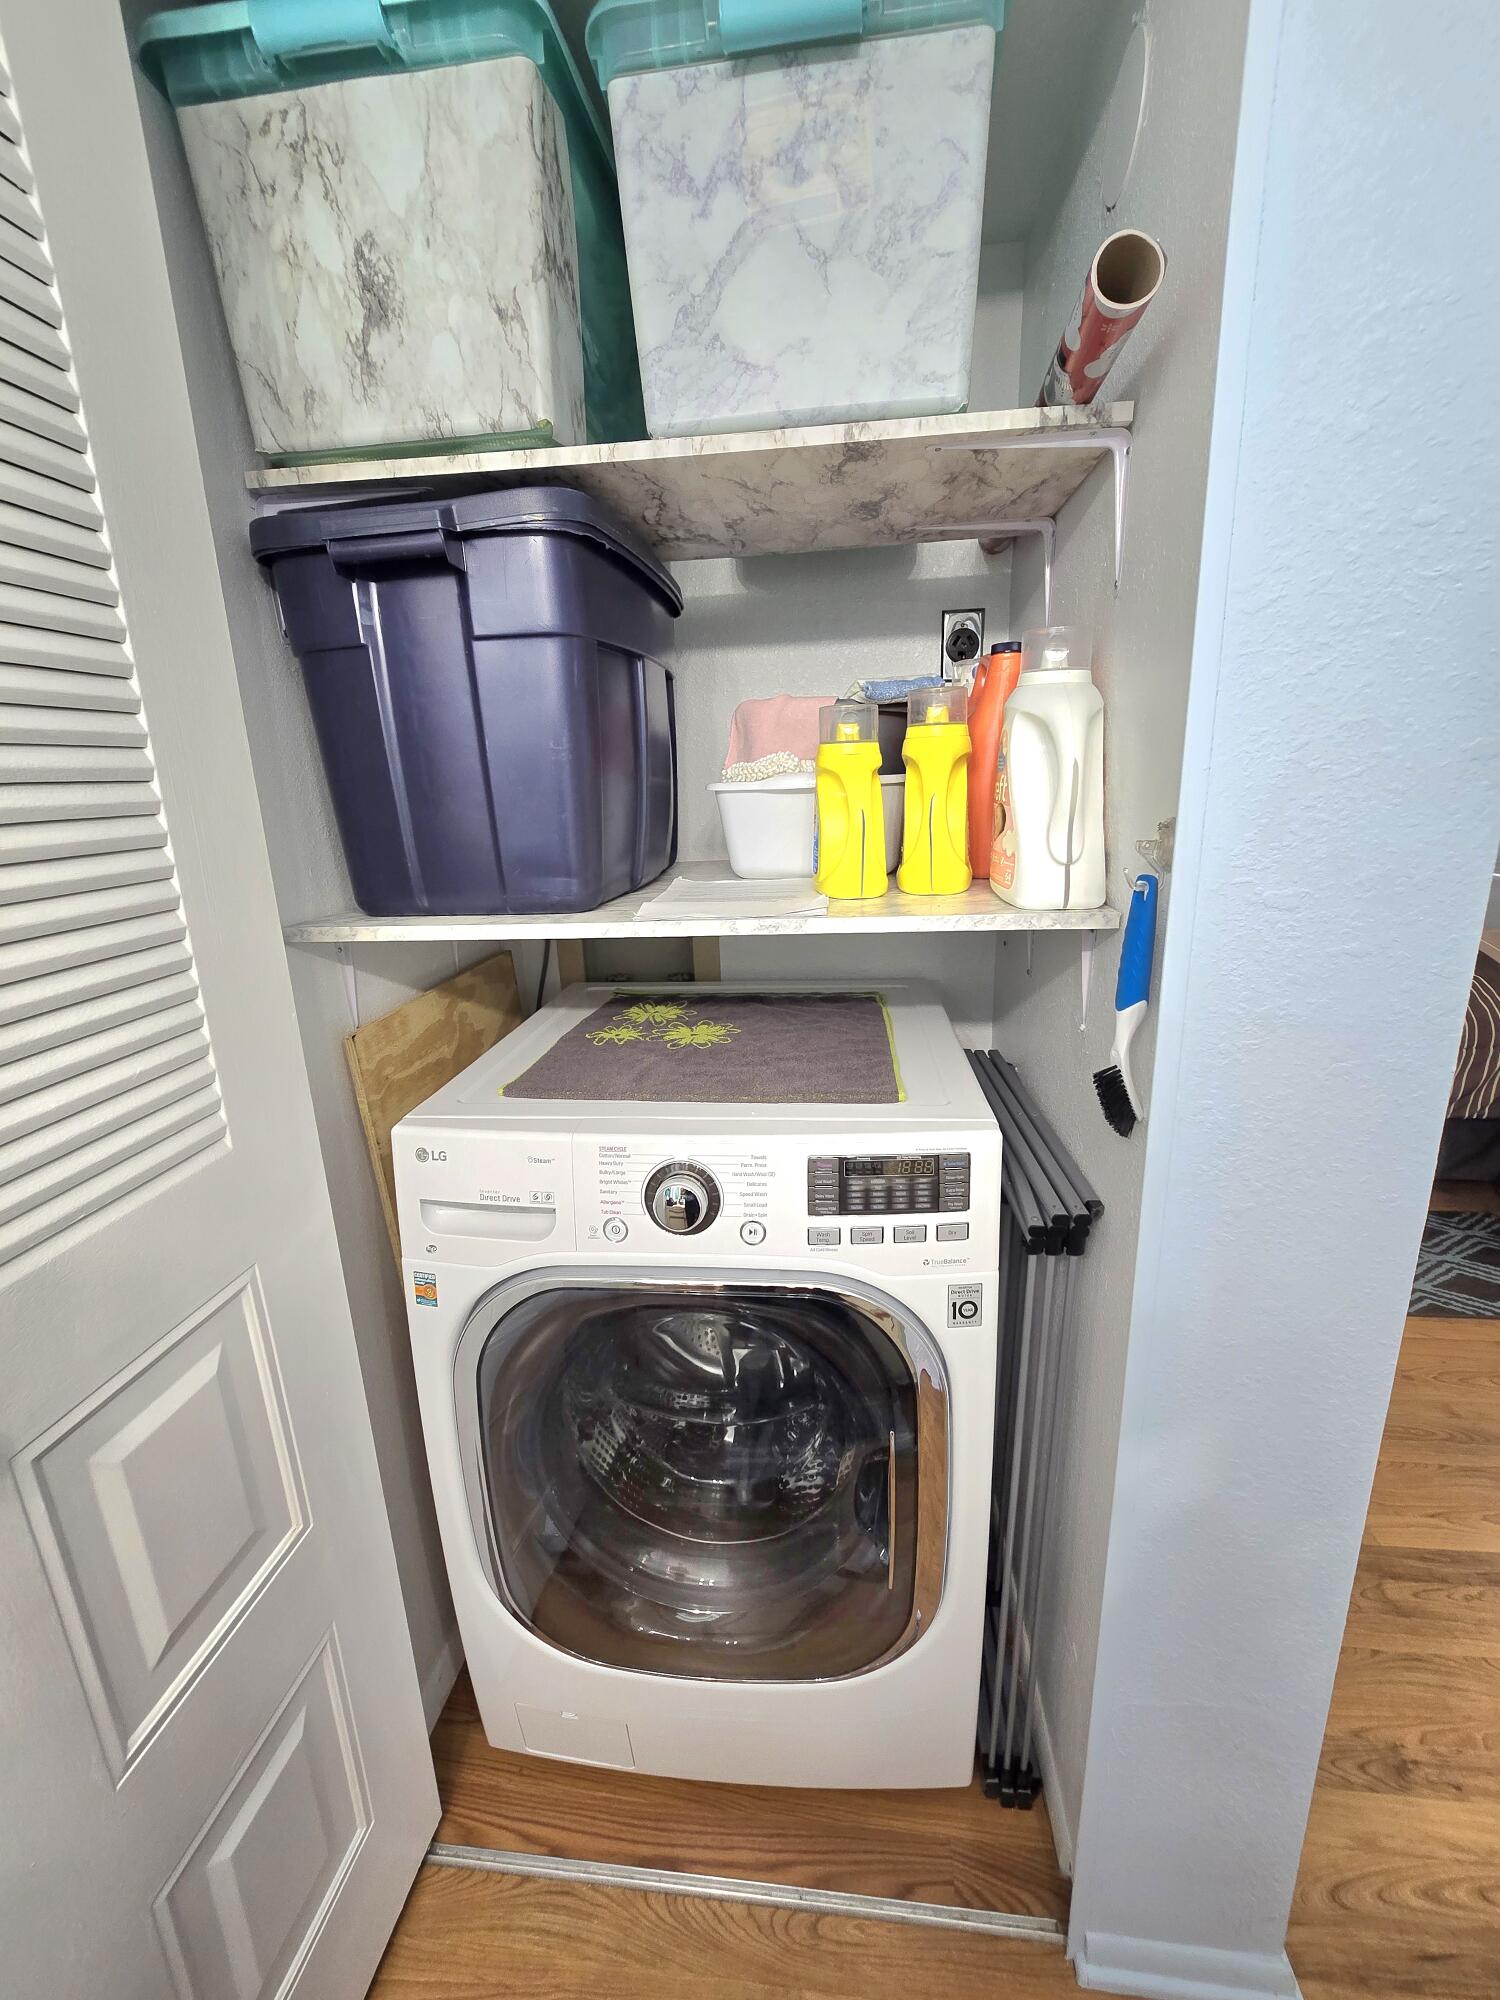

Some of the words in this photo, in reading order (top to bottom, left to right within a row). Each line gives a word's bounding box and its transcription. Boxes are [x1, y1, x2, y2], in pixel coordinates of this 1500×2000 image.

[432, 1151, 447, 1161] LG
[480, 1194, 500, 1202] Direct
[502, 1195, 520, 1203] Drive
[952, 1300, 978, 1320] 10
